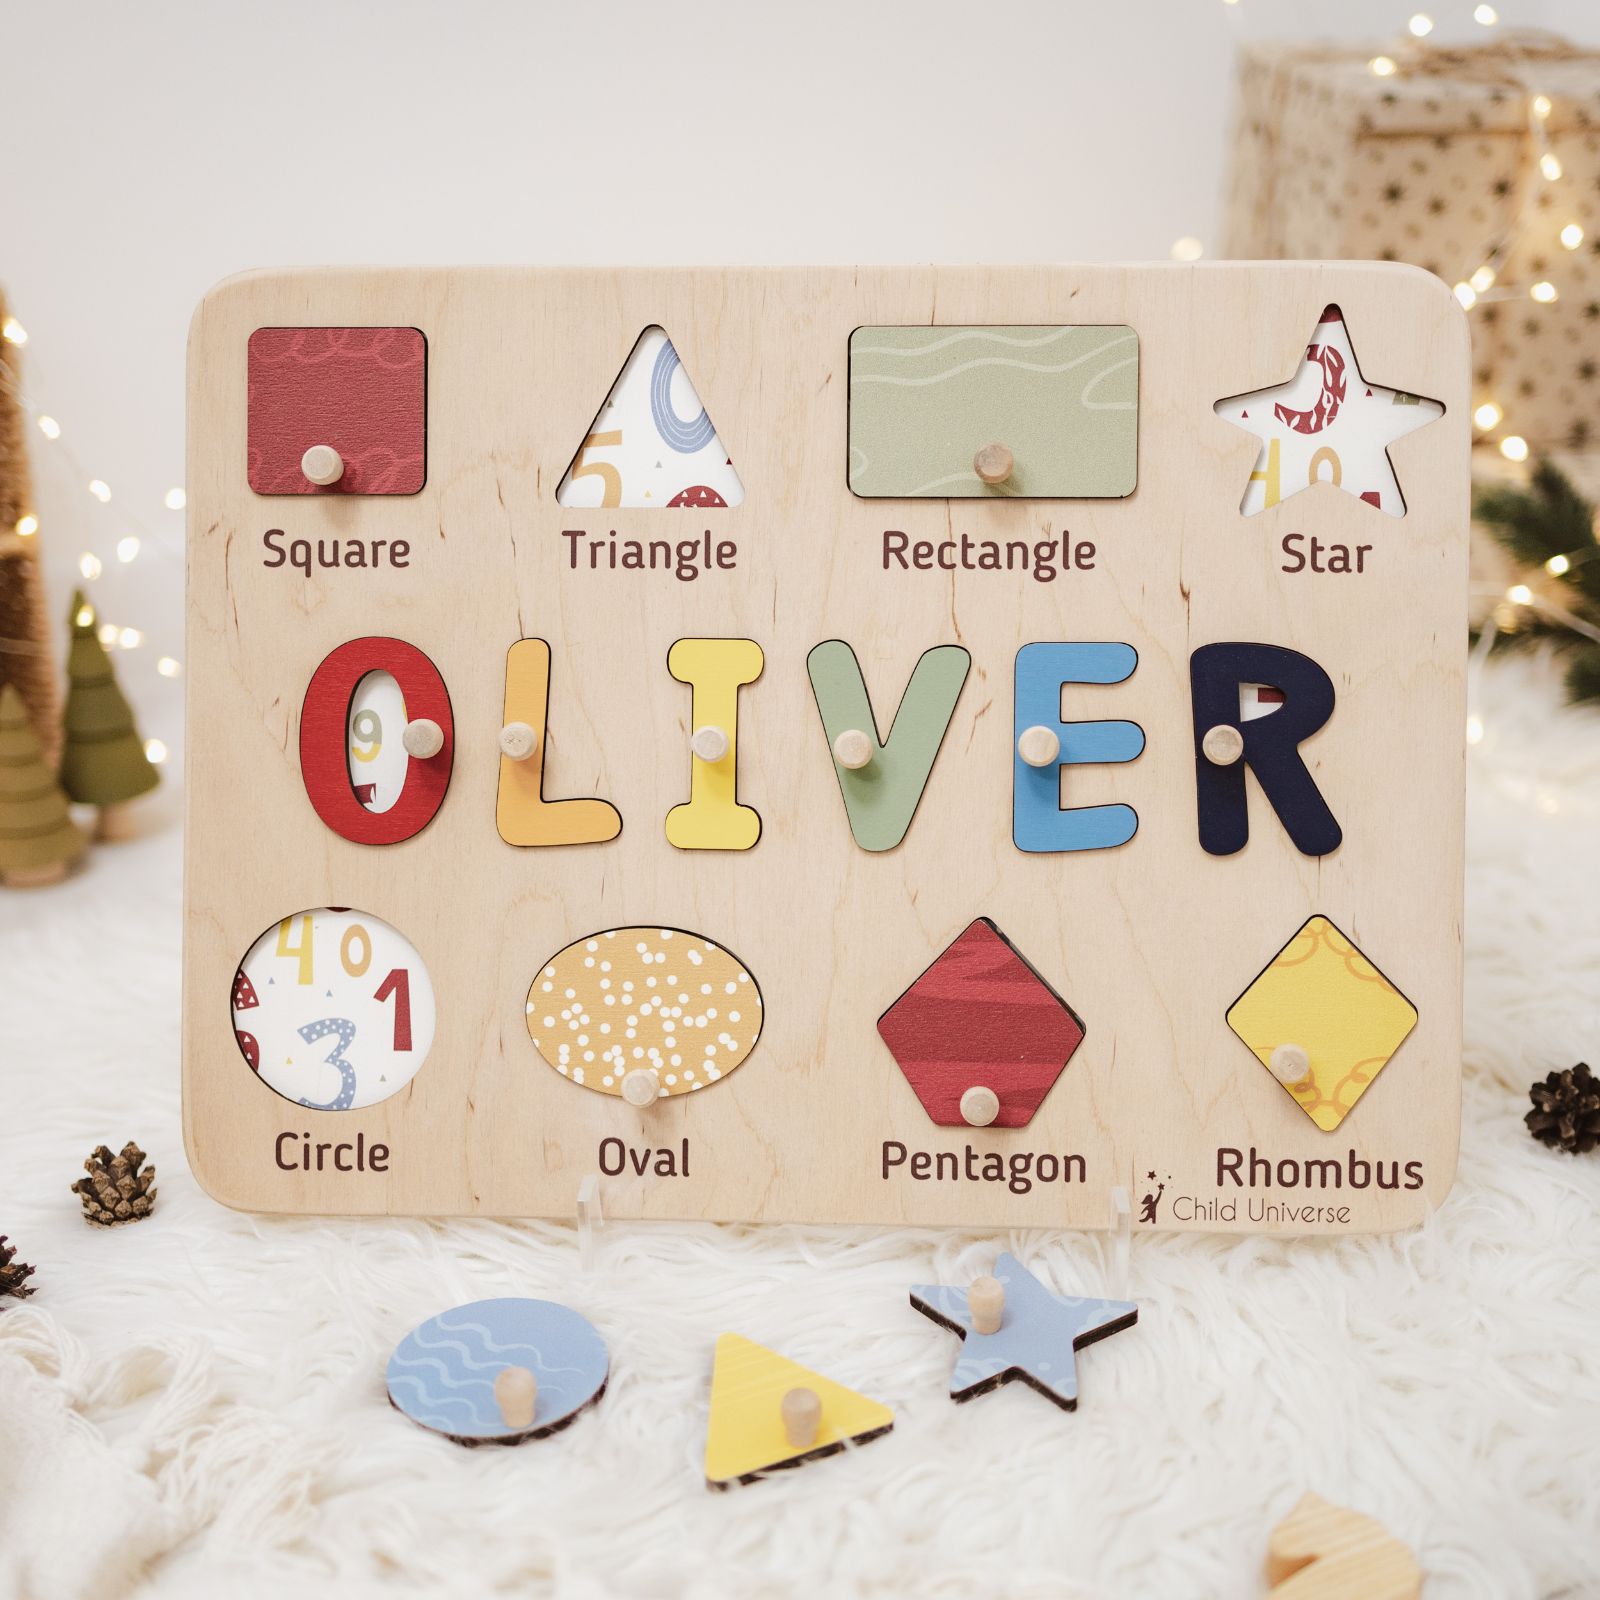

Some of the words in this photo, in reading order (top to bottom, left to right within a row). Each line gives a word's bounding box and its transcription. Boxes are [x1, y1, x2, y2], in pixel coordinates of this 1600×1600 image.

[572, 430, 622, 508] 5
[263, 528, 411, 579] Square
[561, 529, 738, 582] Triangle
[882, 529, 1096, 583] Rectangle
[1281, 533, 1373, 574] Star
[300, 636, 1343, 856] OLIVER
[352, 709, 383, 763] 9
[275, 914, 314, 985] 4
[340, 923, 372, 978] 0
[373, 968, 413, 1051] 1
[297, 1017, 357, 1111] 3
[275, 1131, 390, 1173] Circle
[598, 1137, 690, 1178] Oval
[882, 1140, 1086, 1195] Pentagon
[1216, 1146, 1424, 1190] Rhombus
[1172, 1196, 1237, 1224] Child
[1248, 1197, 1351, 1224] Universe
